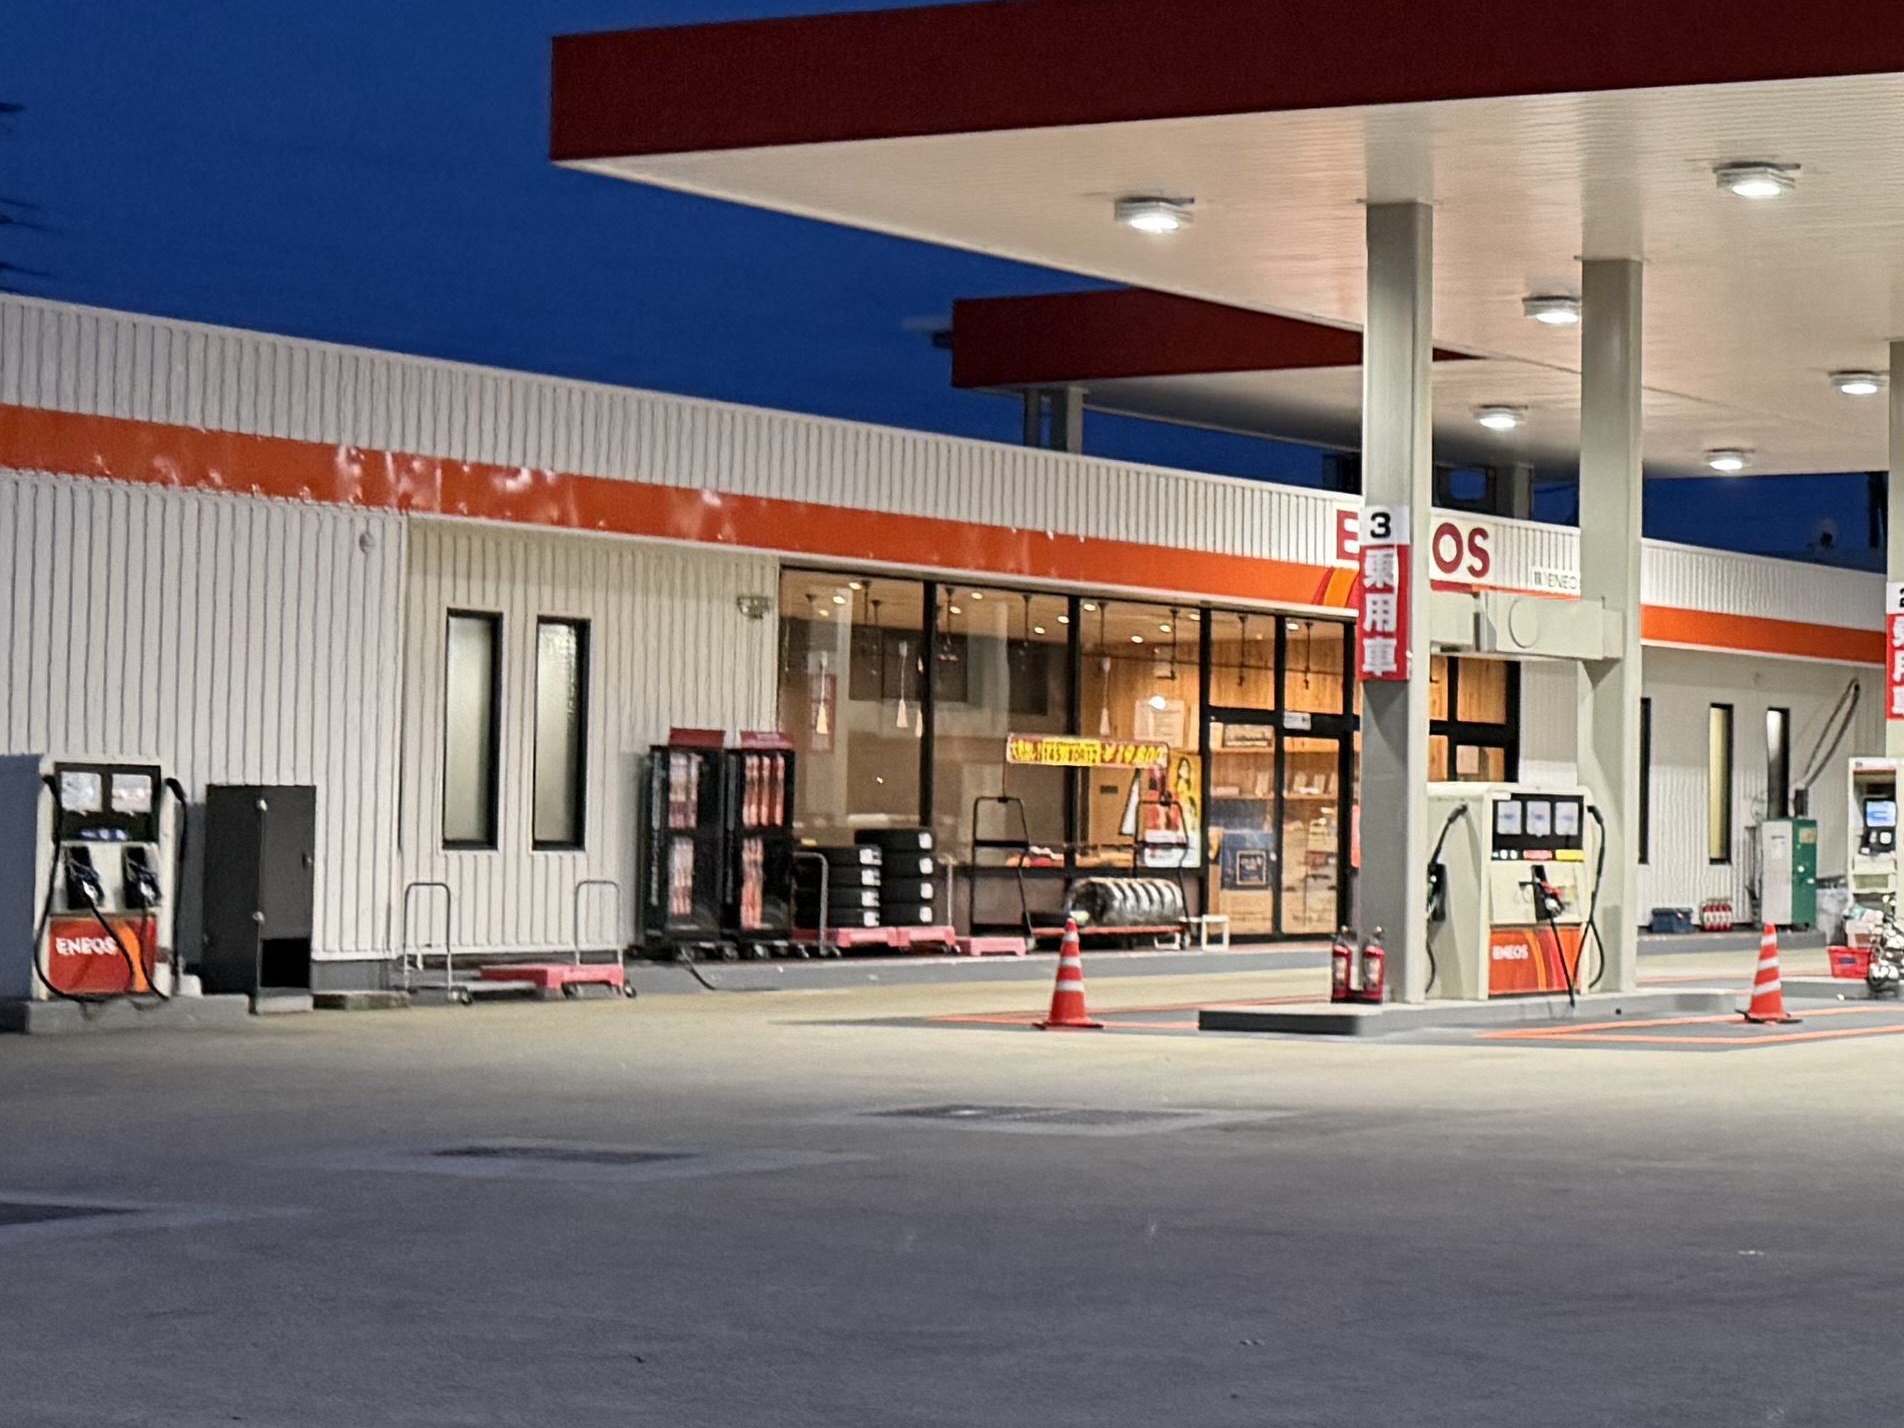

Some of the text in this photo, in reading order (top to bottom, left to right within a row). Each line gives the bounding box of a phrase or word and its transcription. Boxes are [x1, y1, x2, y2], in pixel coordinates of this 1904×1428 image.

[1370, 512, 1392, 539] 3
[1362, 548, 1399, 677] 乗用車
[55, 936, 118, 956] ENEOS
